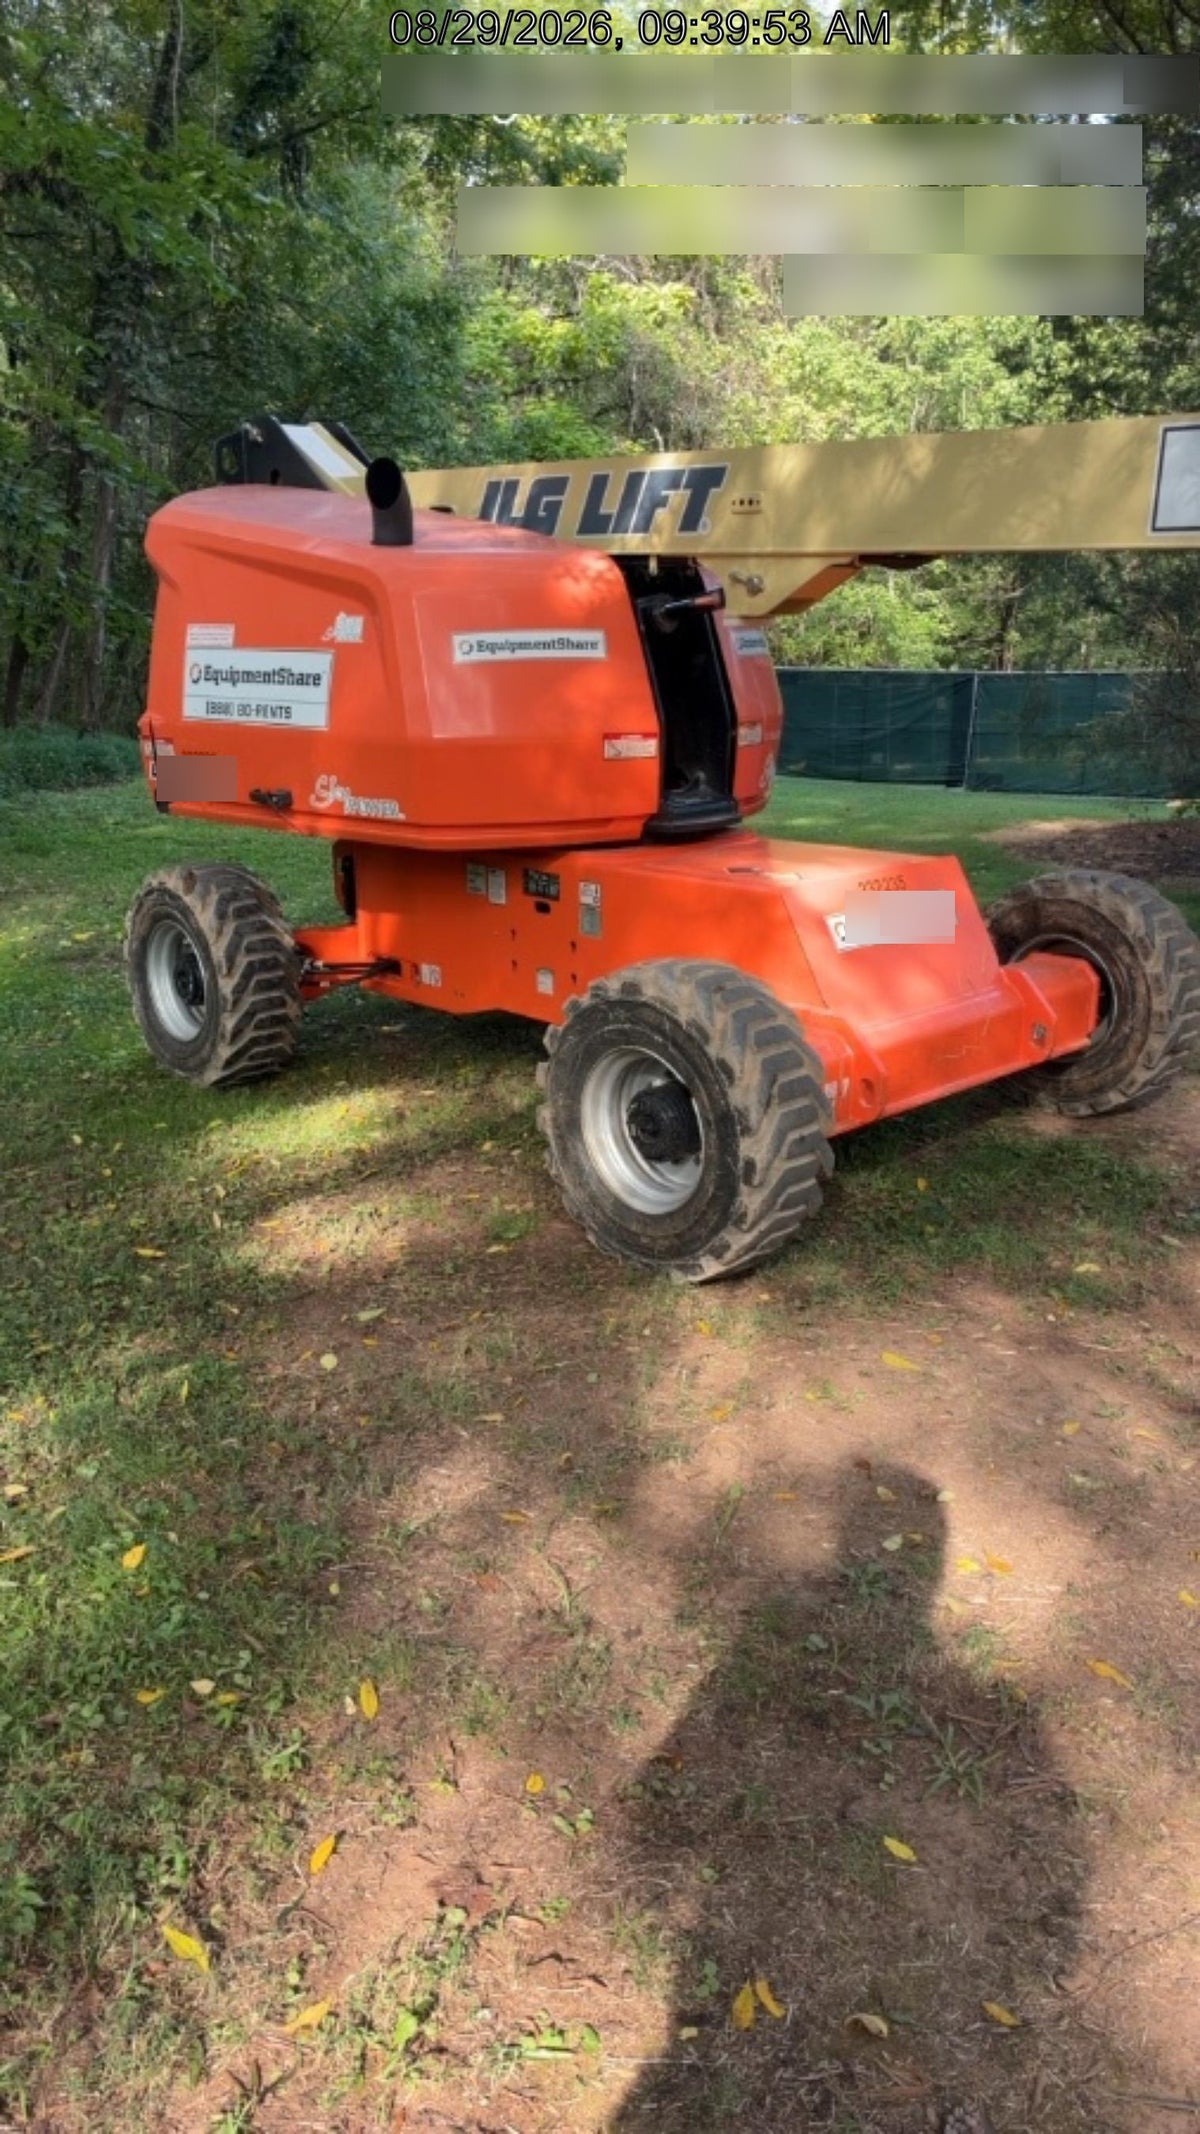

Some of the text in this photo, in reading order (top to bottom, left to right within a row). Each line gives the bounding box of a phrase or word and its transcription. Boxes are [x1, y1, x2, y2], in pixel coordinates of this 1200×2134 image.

[575, 463, 732, 539] LIFT
[475, 637, 600, 655] EquipmentShare
[203, 664, 322, 687] EquipmentShare
